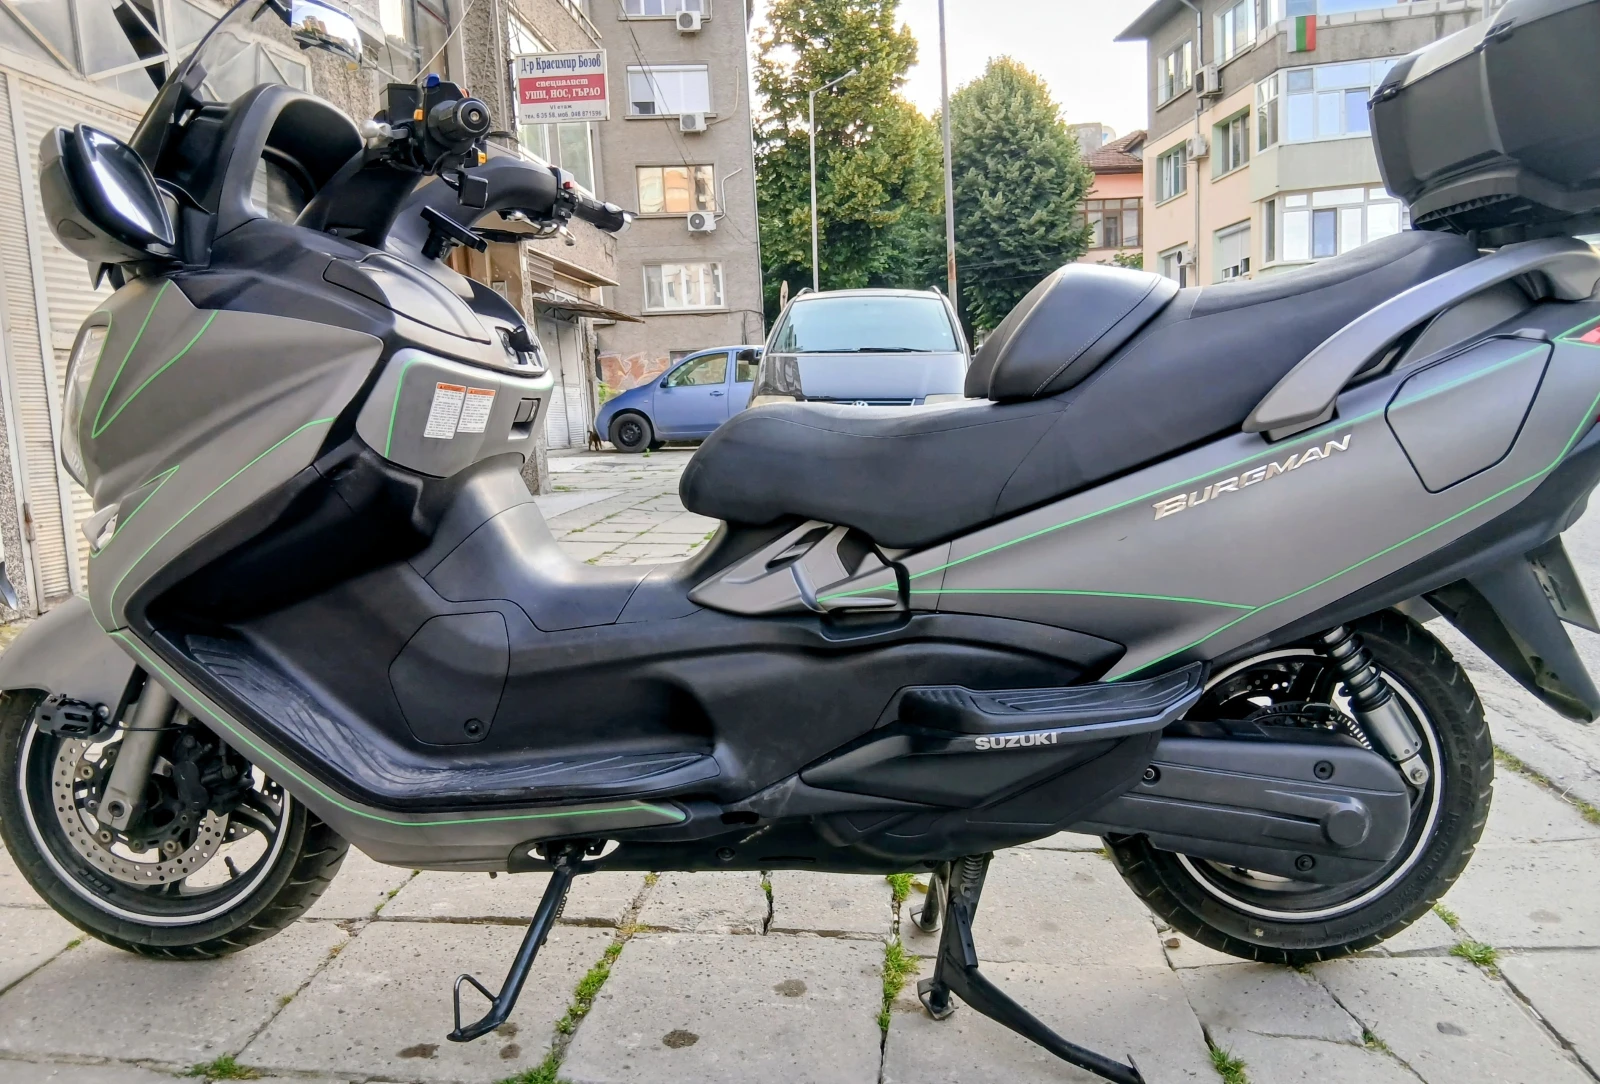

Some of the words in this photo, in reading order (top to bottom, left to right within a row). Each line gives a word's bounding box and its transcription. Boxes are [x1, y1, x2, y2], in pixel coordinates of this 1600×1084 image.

[521, 58, 534, 74] Д-р
[536, 57, 577, 73] Красимир
[578, 53, 601, 68] Бозов
[536, 78, 588, 88] специалист
[525, 90, 549, 100] УШИ,
[550, 89, 571, 99] НОС,
[572, 87, 601, 97] ГЪРЛО
[1151, 433, 1352, 521] BURGMAN
[974, 731, 1058, 750] SUZUKI
